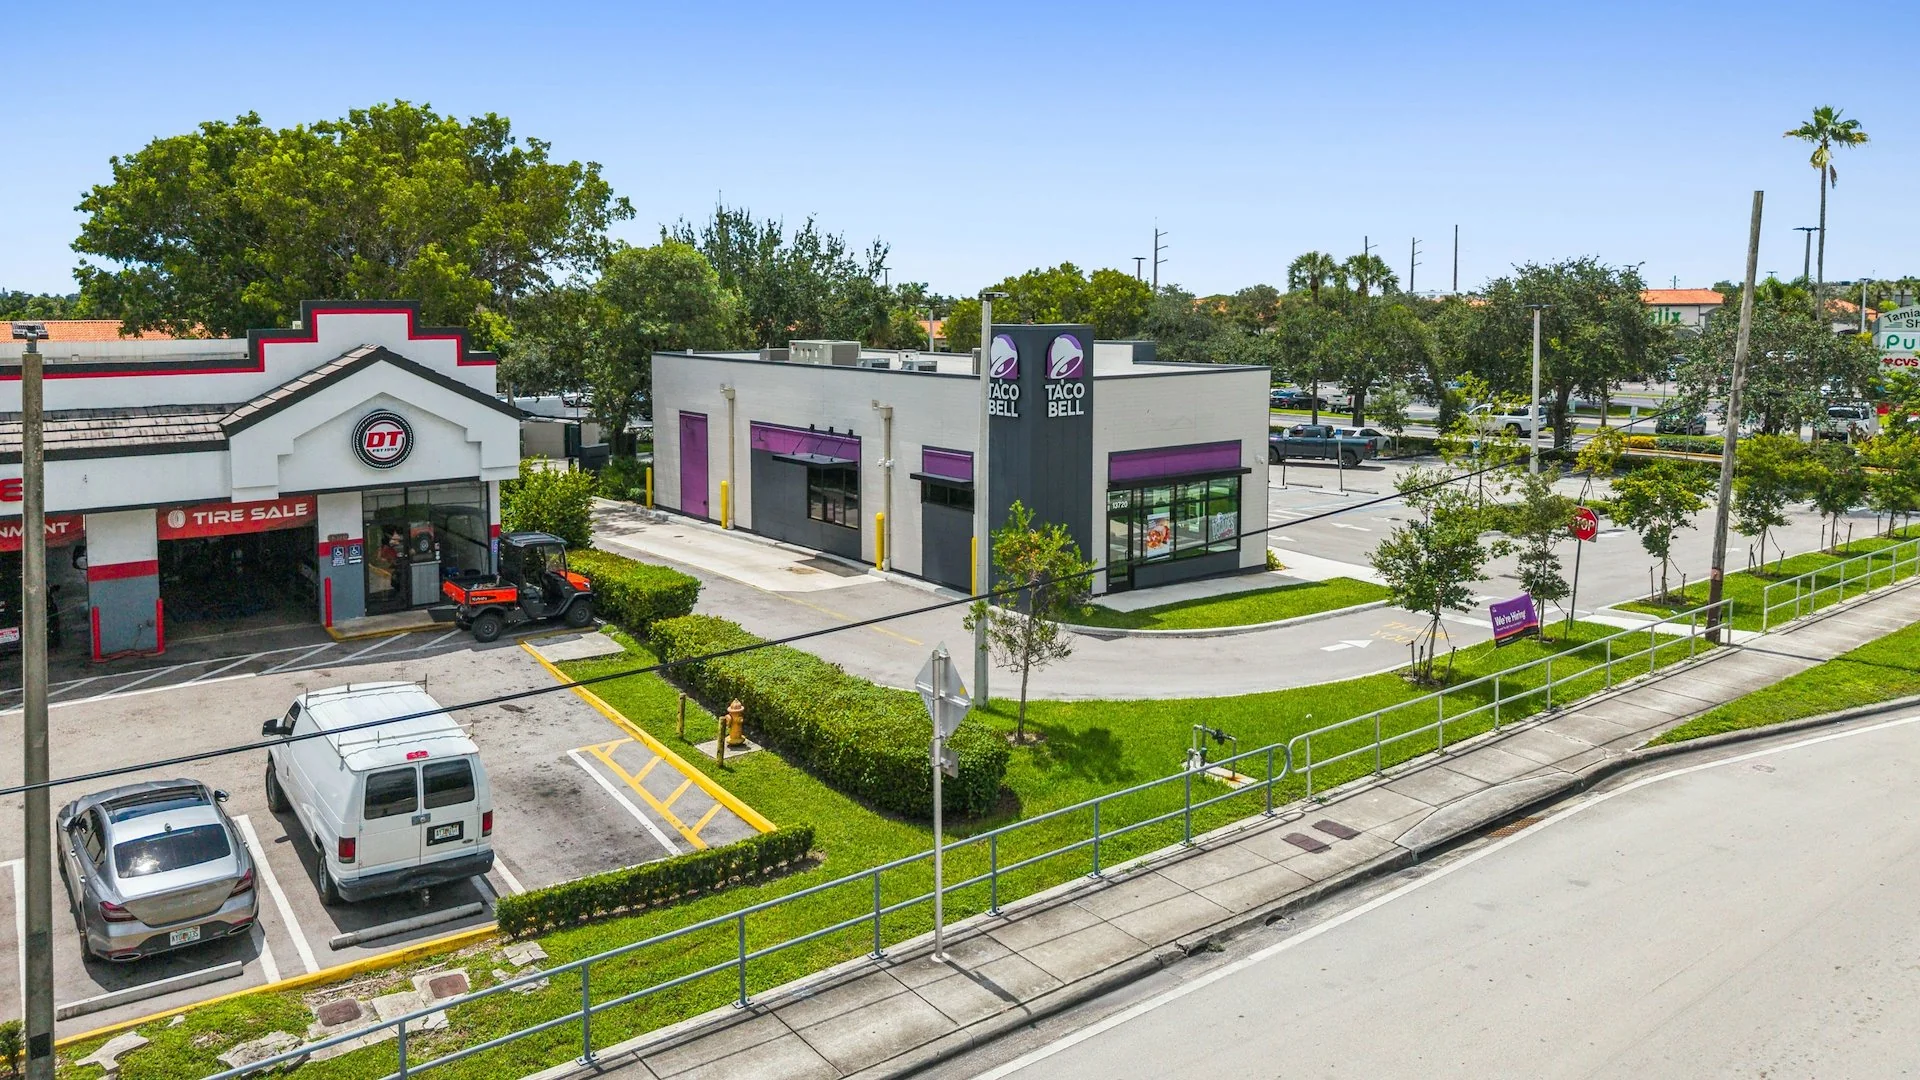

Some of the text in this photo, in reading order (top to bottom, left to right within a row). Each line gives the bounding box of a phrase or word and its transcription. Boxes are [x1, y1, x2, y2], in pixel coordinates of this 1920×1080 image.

[1894, 358, 1919, 367] CVS
[988, 383, 1019, 400] TACO
[1045, 383, 1085, 400] TACO
[988, 400, 1018, 417] BELL
[1048, 400, 1084, 417] BELL
[366, 431, 403, 448] DT
[1112, 500, 1128, 509] 13720
[193, 503, 307, 525] TIRE SALE
[1494, 614, 1512, 627] We're
